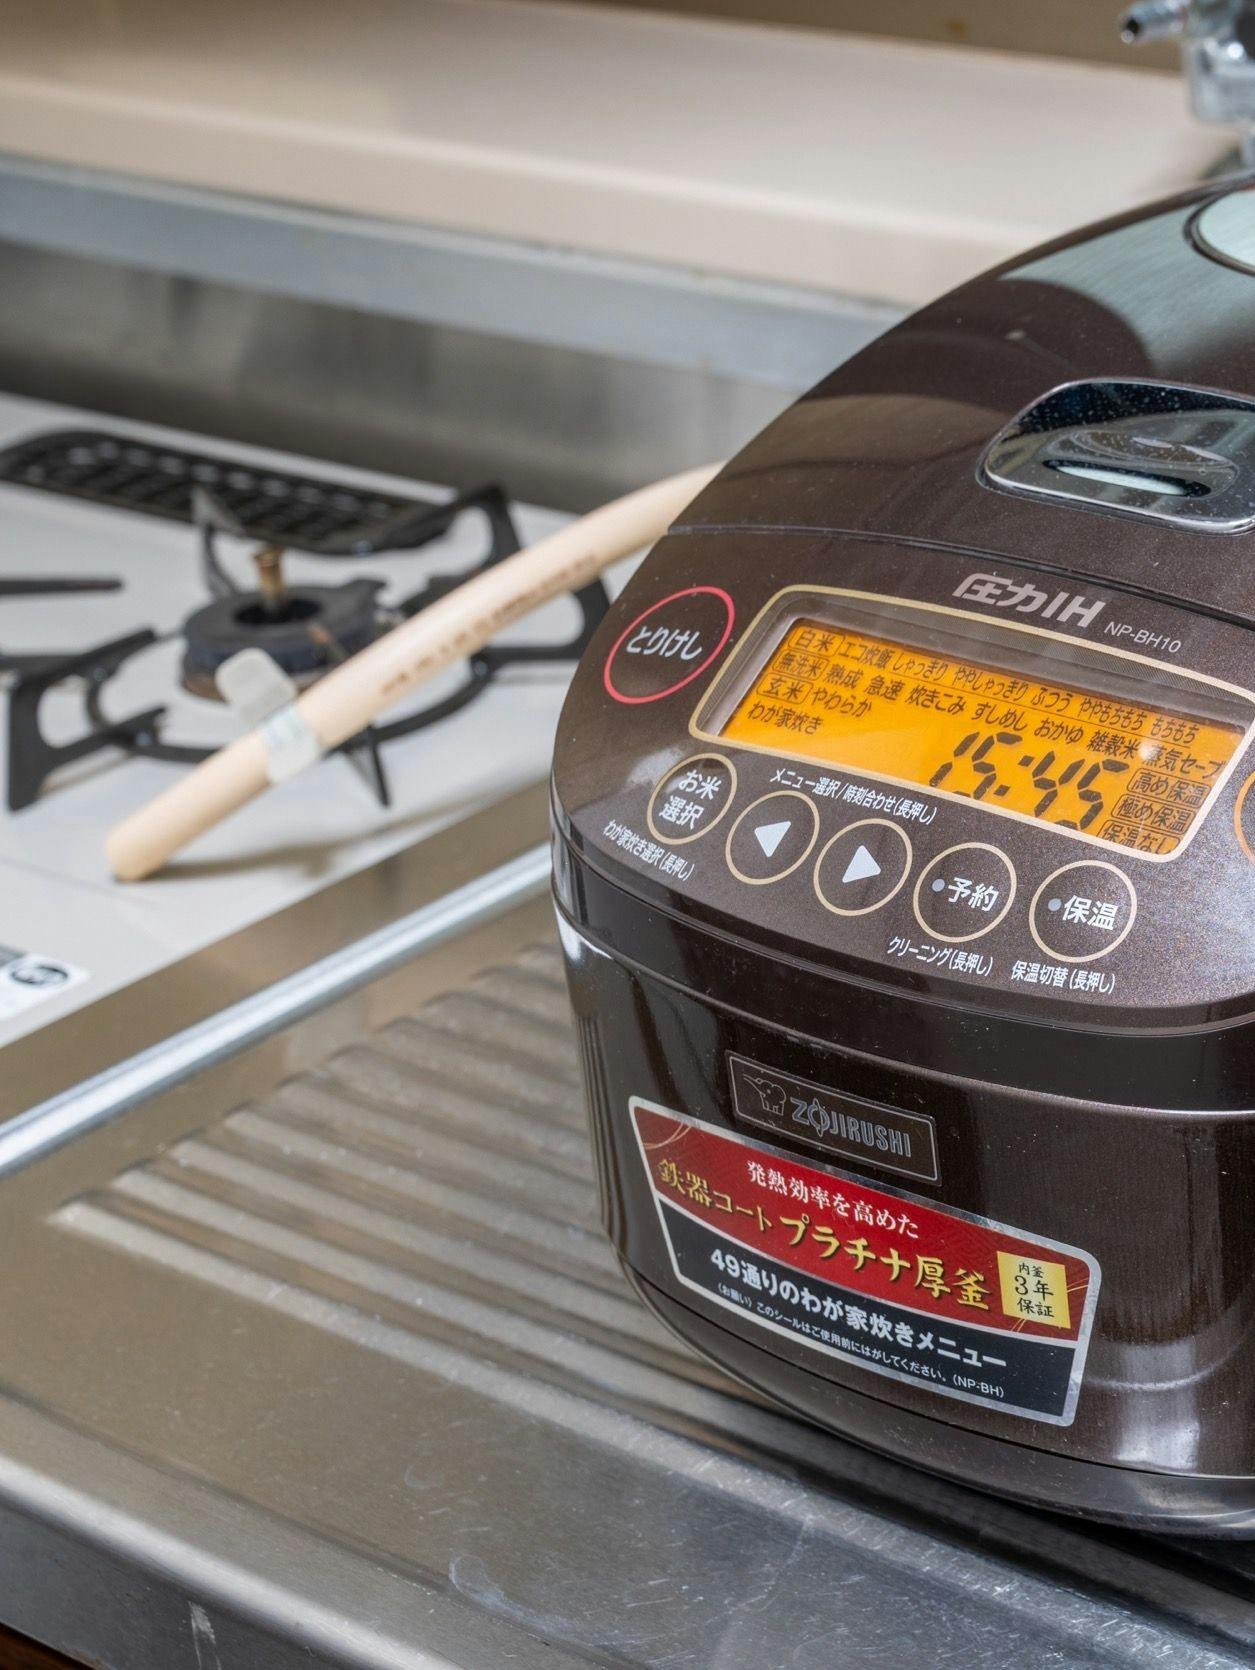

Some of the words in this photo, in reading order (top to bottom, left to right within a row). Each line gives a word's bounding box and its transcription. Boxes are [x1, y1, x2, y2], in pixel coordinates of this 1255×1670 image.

[951, 572, 1107, 628] 圧力IH
[626, 625, 702, 661] とりけし
[1103, 621, 1182, 653] NP-BH10
[762, 677, 805, 701] 玄米
[811, 686, 873, 718] やわらか
[796, 629, 834, 653] 白米
[838, 642, 895, 670] エコ炊飯
[893, 652, 949, 682] しゃっきり
[952, 664, 1029, 702] ややしゃっきり
[1031, 686, 1073, 712] ふつう
[1077, 697, 1148, 731] ややもちもち
[1150, 714, 1200, 745] もちもち
[747, 701, 825, 736] わが家炊き
[775, 652, 826, 679] 無洗米
[825, 662, 865, 690] 熟成
[864, 674, 906, 701] 急速
[905, 684, 967, 716] 炊きこみ
[971, 701, 1028, 732] すしめし
[1034, 718, 1084, 745] おかゆ
[1087, 730, 1141, 760] 雑穀米
[679, 769, 722, 800] お米
[929, 731, 1130, 831] 15:45
[1133, 771, 1208, 806] 高め保温
[659, 795, 705, 830] 選択
[948, 877, 999, 912] 予約
[1062, 894, 1119, 931] 保温
[790, 1098, 911, 1158] ZOJIRUSHI
[747, 1161, 919, 1239] 発熱効率を高めた
[1014, 1275, 1055, 1302] 3年
[1019, 1262, 1044, 1279] 内釜
[710, 1248, 1007, 1369] 49通りのわが家炊きメニュー
[1016, 1297, 1055, 1318] 保証
